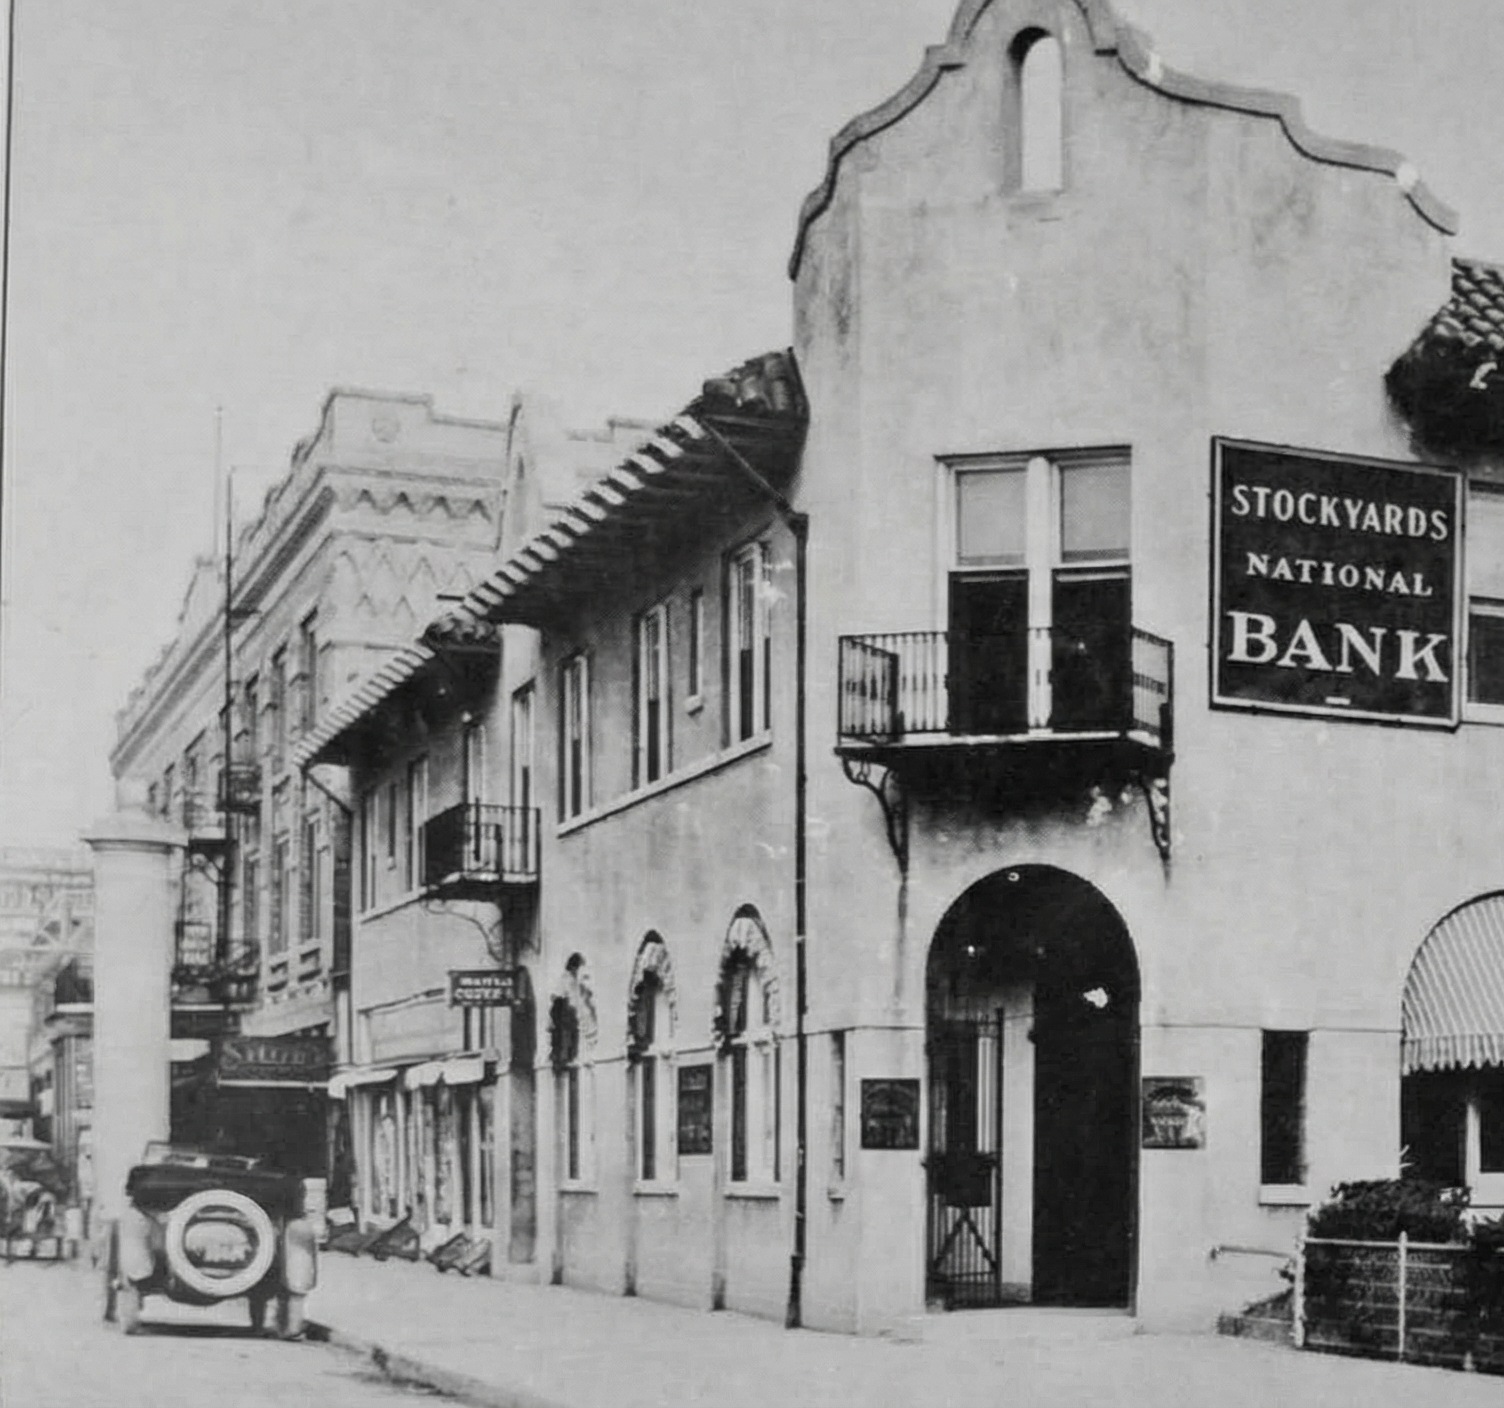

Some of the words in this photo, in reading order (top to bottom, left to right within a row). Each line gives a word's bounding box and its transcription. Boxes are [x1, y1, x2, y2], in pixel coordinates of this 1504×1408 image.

[1231, 484, 1448, 541] STOCKYARDS
[1246, 552, 1433, 597] NATIONAL
[1226, 610, 1449, 682] BANK
